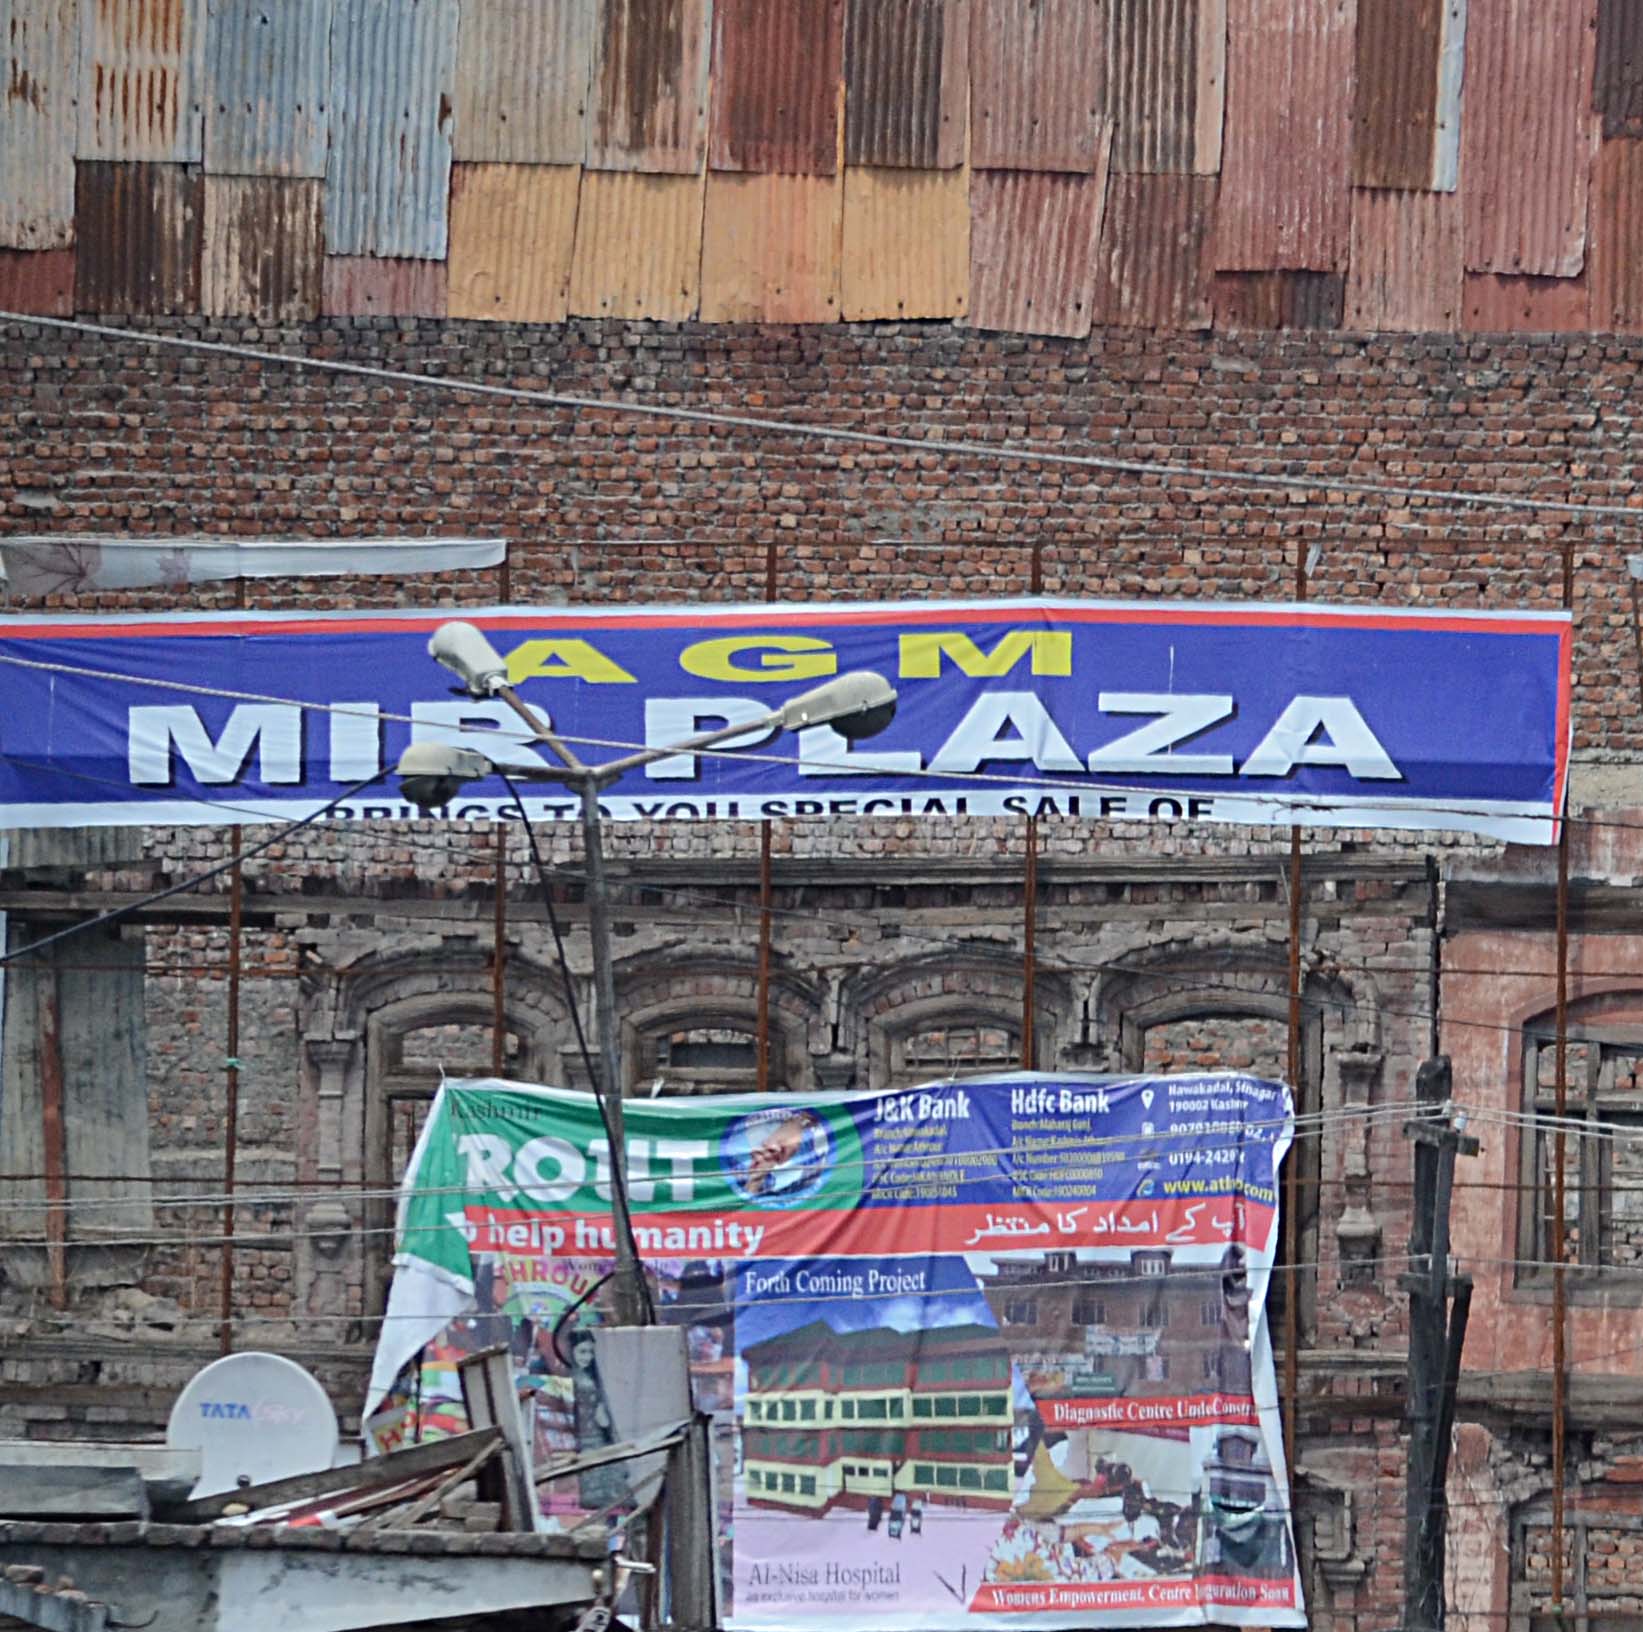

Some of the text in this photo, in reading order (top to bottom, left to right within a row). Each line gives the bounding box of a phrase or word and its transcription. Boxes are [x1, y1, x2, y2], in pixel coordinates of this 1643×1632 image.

[129, 690, 1402, 785] MIR PLAZA
[874, 1087, 1110, 1122] J&K Bank Hdfc Bank
[489, 1218, 565, 1252] help
[585, 1218, 765, 1256] humanity
[745, 1268, 926, 1300] Forth Coming Project
[198, 1402, 252, 1420] TATA
[1126, 1401, 1174, 1421] Centre
[825, 1560, 901, 1591] Hospital
[991, 1588, 1045, 1607] Womens
[1148, 1584, 1192, 1603] Centre
